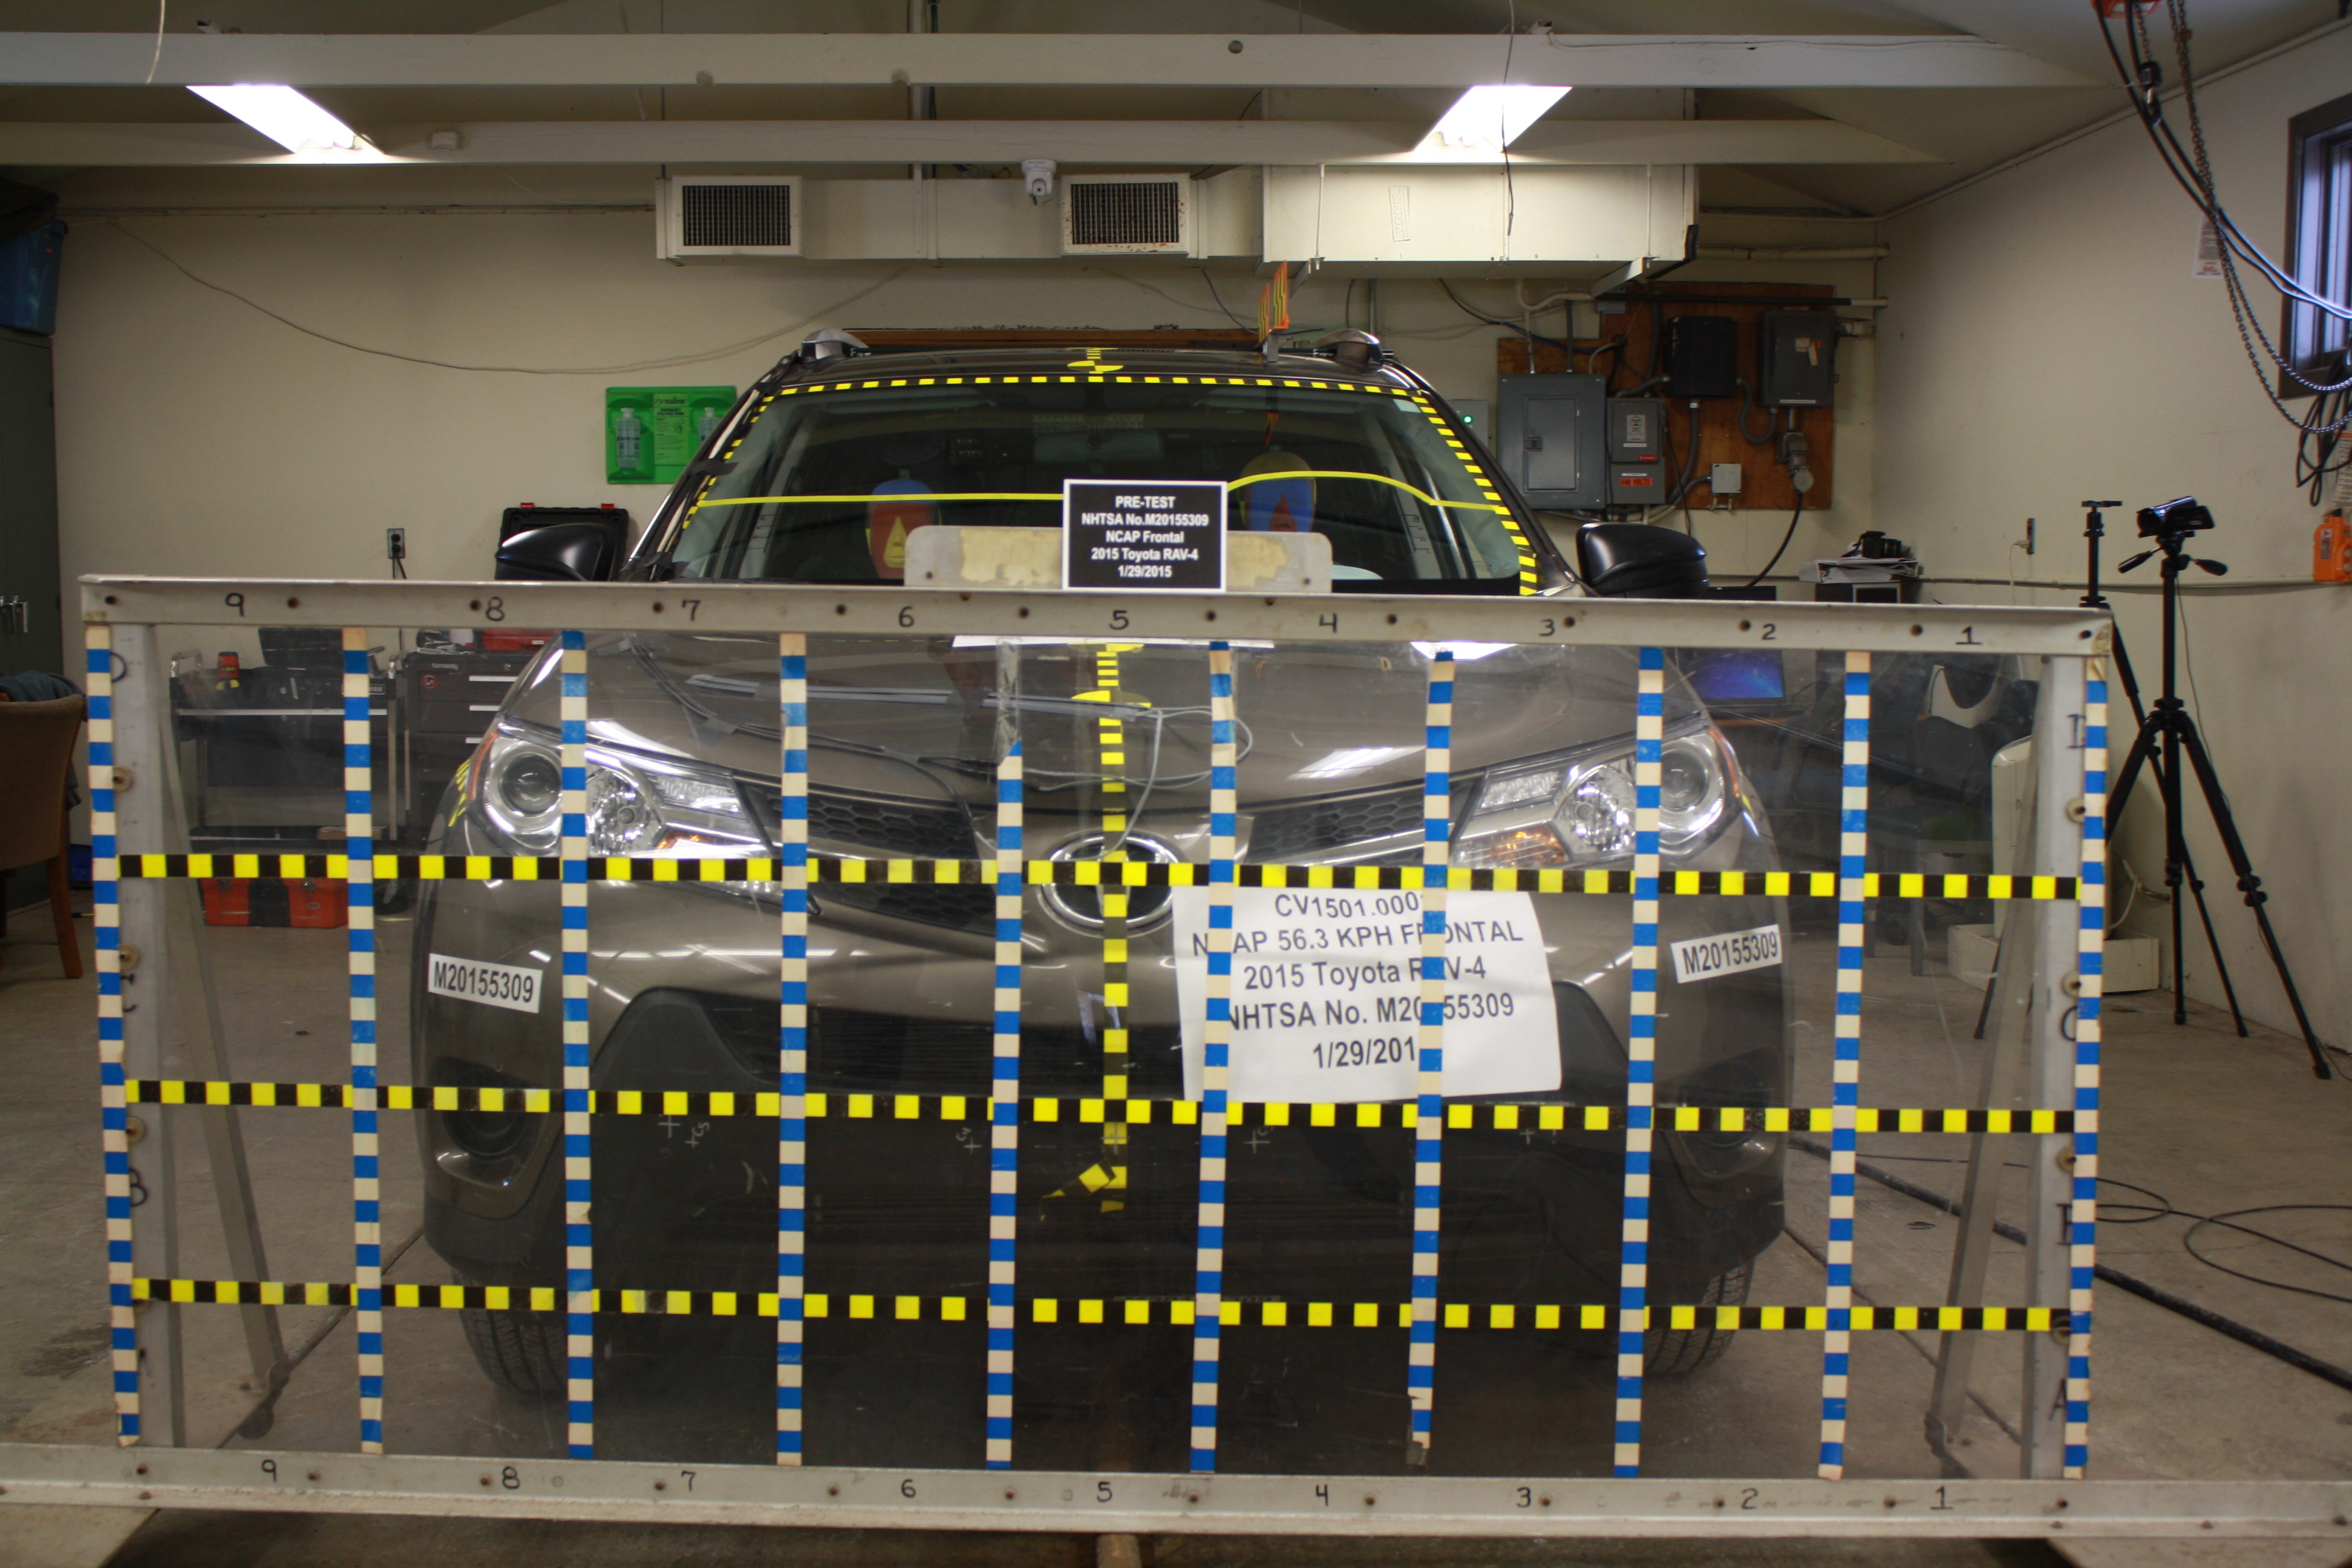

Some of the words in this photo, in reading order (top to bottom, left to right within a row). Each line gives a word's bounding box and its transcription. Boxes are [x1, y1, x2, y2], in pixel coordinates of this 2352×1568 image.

[1392, 194, 1404, 235] YORK
[1115, 495, 1176, 509] PRE-TEST
[1081, 513, 1124, 525] NHTSA
[1125, 514, 1209, 526] No.M20155309
[1106, 530, 1141, 543] NCAP
[1143, 531, 1184, 543] Frontal
[1091, 547, 1119, 560] 2015
[1121, 548, 1161, 563] Toyota
[1163, 549, 1199, 560] RAV-4
[1118, 565, 1172, 577] 1/29/2015
[226, 593, 244, 616] 9
[486, 596, 505, 622] 8
[681, 599, 701, 621] 7
[898, 606, 914, 627] 6
[1109, 610, 1129, 630] 5
[1319, 613, 1338, 633] 4
[1540, 618, 1555, 636] 3
[1762, 623, 1777, 640] 2
[1956, 626, 1981, 645] 1
[1274, 892, 1423, 918] CV1501.000
[1192, 931, 1267, 956] NAP
[1278, 928, 1328, 951] 56.3
[1336, 926, 1393, 949] KPH
[1682, 931, 1777, 975] M20155309
[434, 961, 534, 1003] M20155309
[1244, 963, 1304, 990] 2015
[1312, 961, 1400, 991] Toyota
[1408, 955, 1486, 981] RV-4
[1325, 1000, 1367, 1025] No.
[1376, 992, 1514, 1022] M2055309
[1312, 1036, 1416, 1068] 1/29/201
[261, 1459, 277, 1482] 9
[501, 1466, 520, 1490] 8
[681, 1470, 696, 1492] 7
[901, 1478, 916, 1498] 6
[1097, 1481, 1113, 1503] 5
[1315, 1484, 1329, 1506] 4
[1517, 1486, 1532, 1508] 3
[1741, 1488, 1759, 1510] 2
[1930, 1486, 1953, 1511] 1
